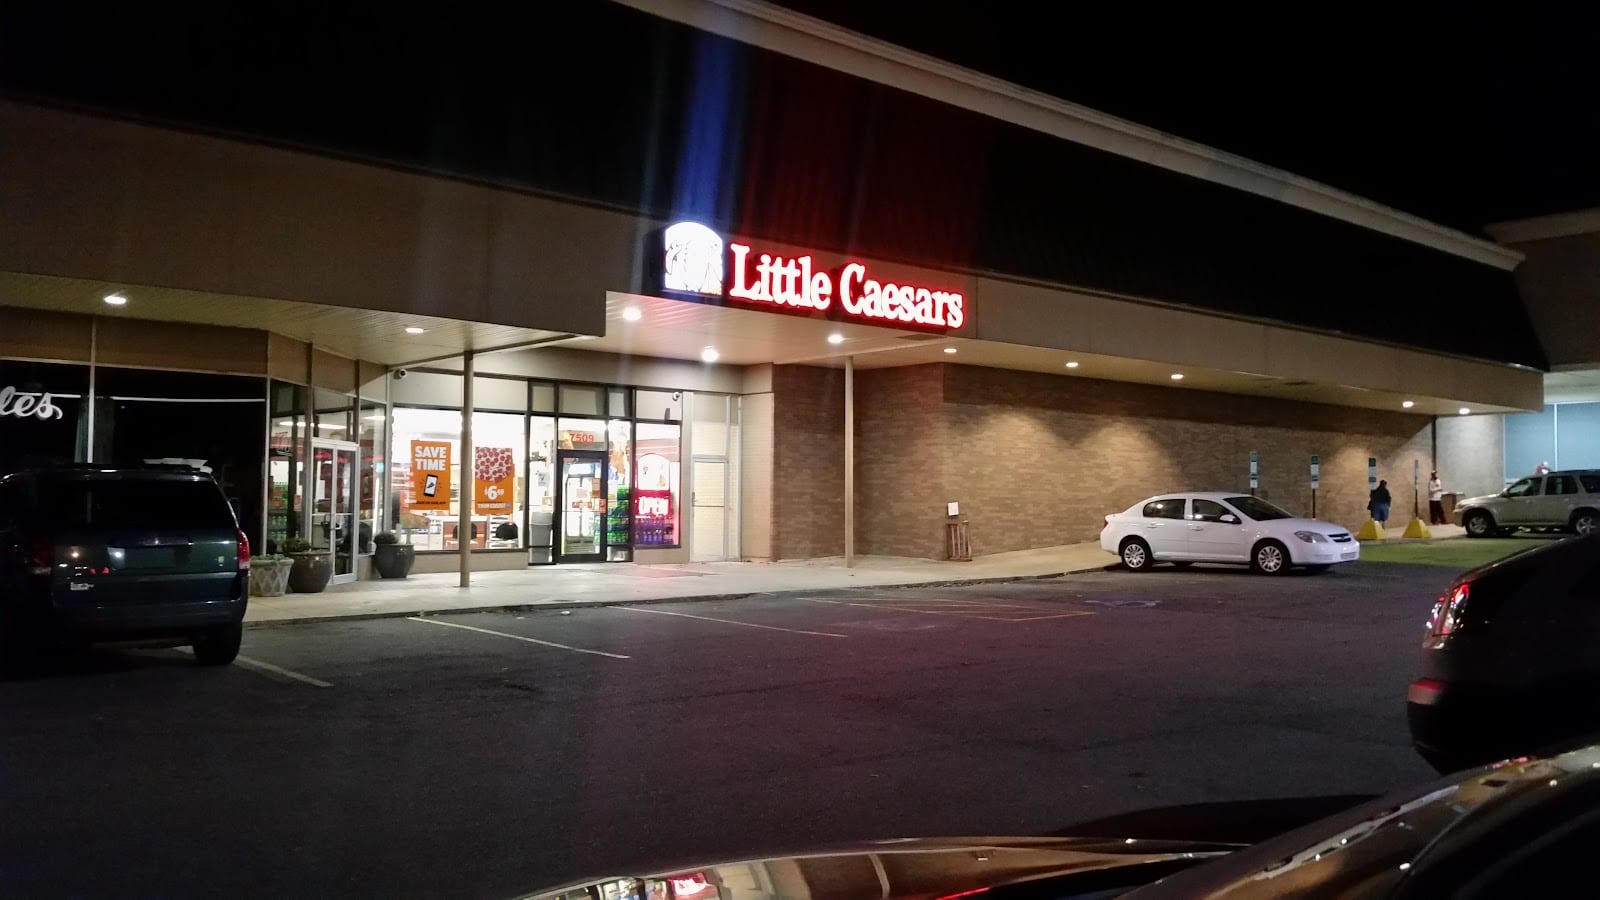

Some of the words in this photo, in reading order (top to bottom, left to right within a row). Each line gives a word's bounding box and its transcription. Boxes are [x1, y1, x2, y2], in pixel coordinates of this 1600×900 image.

[729, 243, 832, 310] Little
[839, 262, 964, 329] Caesars
[569, 432, 594, 444] 7509
[415, 446, 447, 458] SAVE
[415, 458, 446, 470] TIME
[639, 496, 669, 515] OPEN
